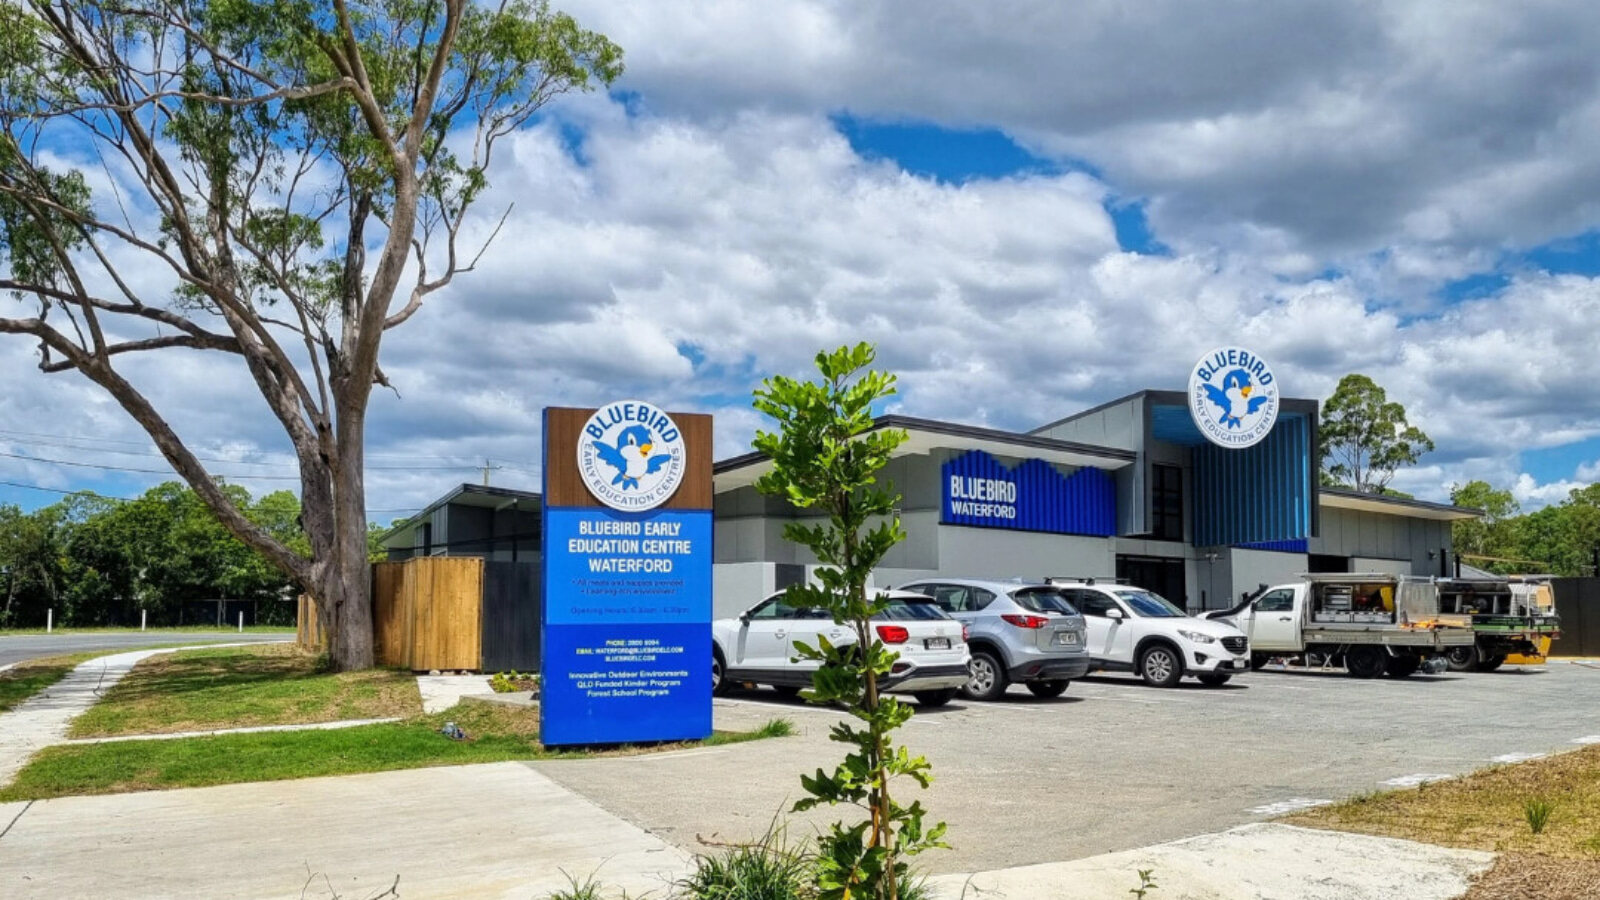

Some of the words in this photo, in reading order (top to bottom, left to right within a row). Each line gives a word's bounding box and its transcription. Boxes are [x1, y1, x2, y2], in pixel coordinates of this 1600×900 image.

[1197, 349, 1273, 386] BLUEBIRD
[1196, 385, 1207, 417] EARLY
[1204, 418, 1254, 443] EDUCATION
[1255, 390, 1275, 434] CENTRES
[586, 403, 679, 443] BLUEBIRD
[583, 443, 596, 479] EARLY
[593, 480, 655, 506] EDUCATION
[656, 447, 681, 496] CENTRES
[950, 475, 1016, 503] BLUEBIRD
[951, 501, 1016, 519] WATERFORD
[579, 521, 641, 536] BLUEBIRD
[644, 522, 681, 536] EARLY
[568, 539, 639, 553] EDUCATION
[642, 540, 691, 554] CENTRE
[588, 558, 673, 573] WATERFORD
[569, 672, 607, 680] Innovative
[608, 671, 638, 679] Outdoor
[639, 670, 689, 678] Environments
[577, 681, 594, 689] QLD
[595, 680, 623, 688] Funded
[650, 679, 681, 688] Program
[612, 689, 637, 697] School
[638, 689, 669, 698] Program
